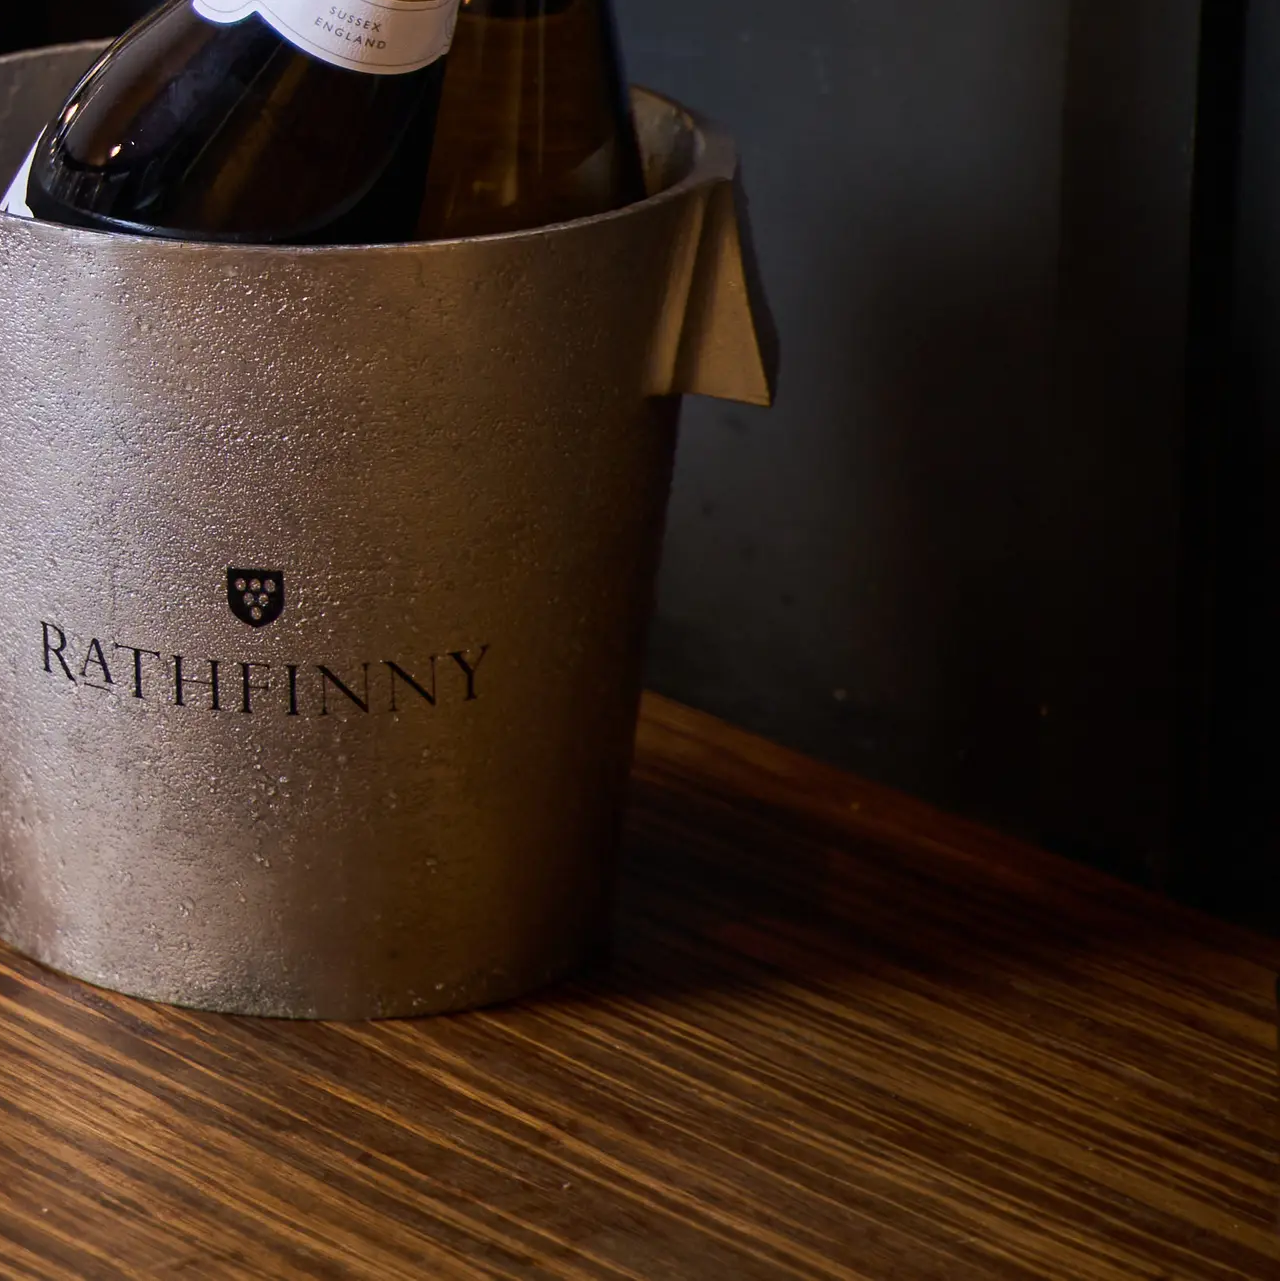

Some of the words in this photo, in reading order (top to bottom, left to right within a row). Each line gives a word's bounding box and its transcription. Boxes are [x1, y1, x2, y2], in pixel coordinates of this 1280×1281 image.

[314, 16, 387, 50] ENGLAND
[329, 5, 382, 33] SUSSEX
[40, 620, 492, 717] RATHFINNY
